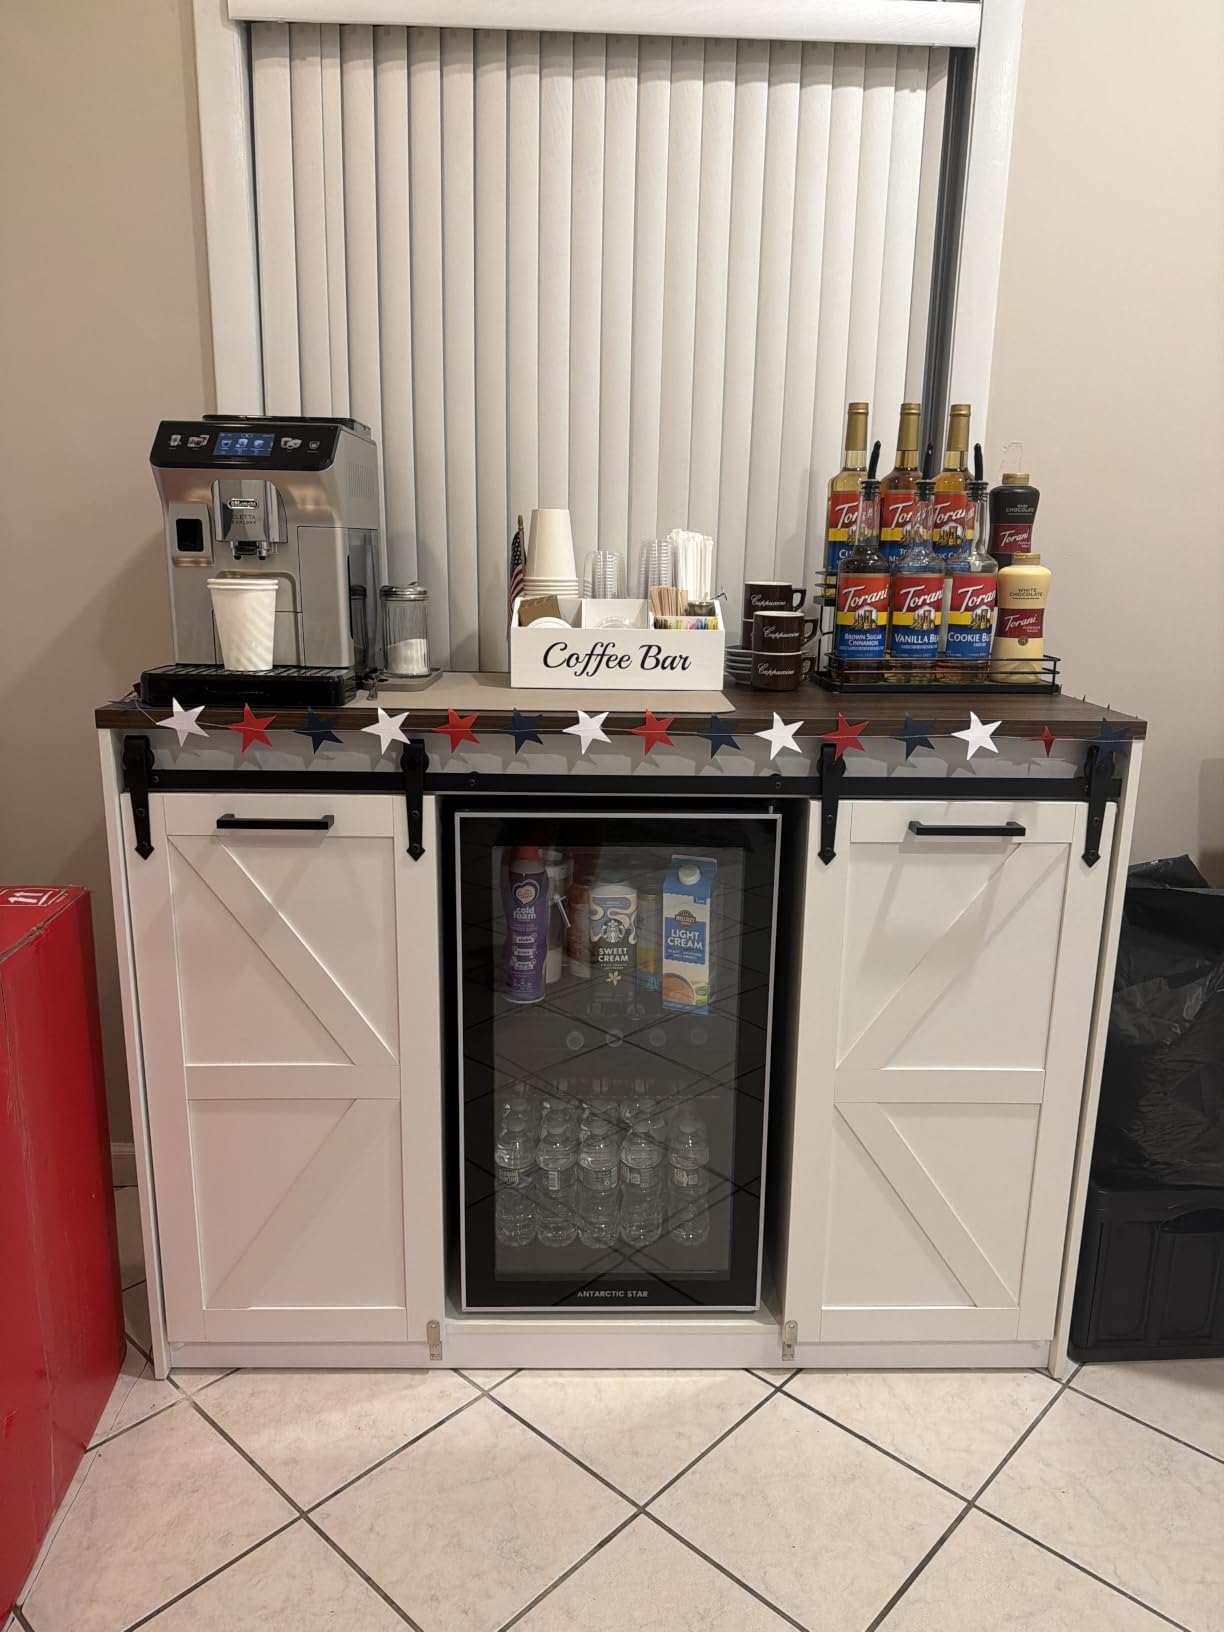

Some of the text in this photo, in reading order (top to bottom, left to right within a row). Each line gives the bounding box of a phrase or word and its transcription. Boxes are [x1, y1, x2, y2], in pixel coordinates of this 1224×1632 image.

[1000, 528, 1030, 547] Torani
[842, 584, 889, 613] Torani
[1004, 614, 1038, 632] Torani
[895, 633, 928, 644] VANILLA
[948, 632, 980, 642] COOKIE
[542, 641, 692, 677] Coffee Bar
[513, 910, 537, 920] foam
[516, 906, 535, 914] cold
[671, 929, 700, 940] LIGHT
[667, 937, 703, 951] CREAM
[598, 947, 629, 955] SWEET
[598, 954, 629, 962] CREAM
[577, 1290, 649, 1298] ANTARCTIC STAR
